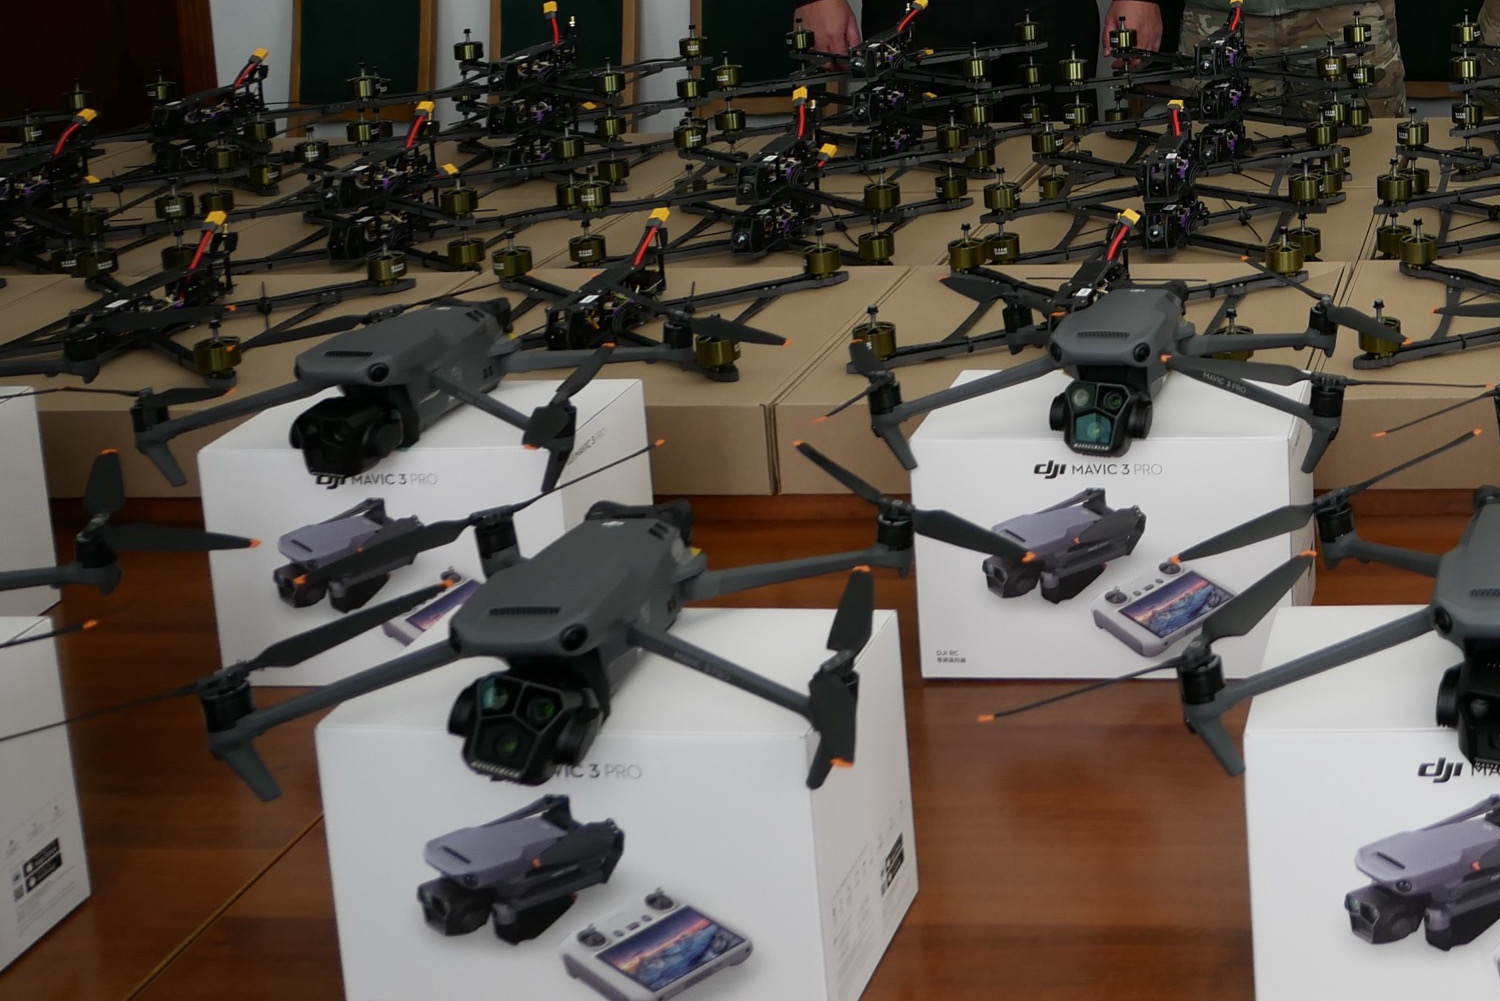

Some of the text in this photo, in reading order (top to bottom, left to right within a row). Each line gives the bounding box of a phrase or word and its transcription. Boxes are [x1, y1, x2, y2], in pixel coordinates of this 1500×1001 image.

[1071, 463, 1118, 475] MAVIC
[1121, 463, 1130, 475] 3
[1134, 463, 1163, 475] PRO
[351, 473, 396, 485] MAVIC
[398, 473, 407, 485] 3
[410, 473, 438, 486] PRO
[589, 763, 600, 778] 3
[604, 763, 643, 779] PRO
